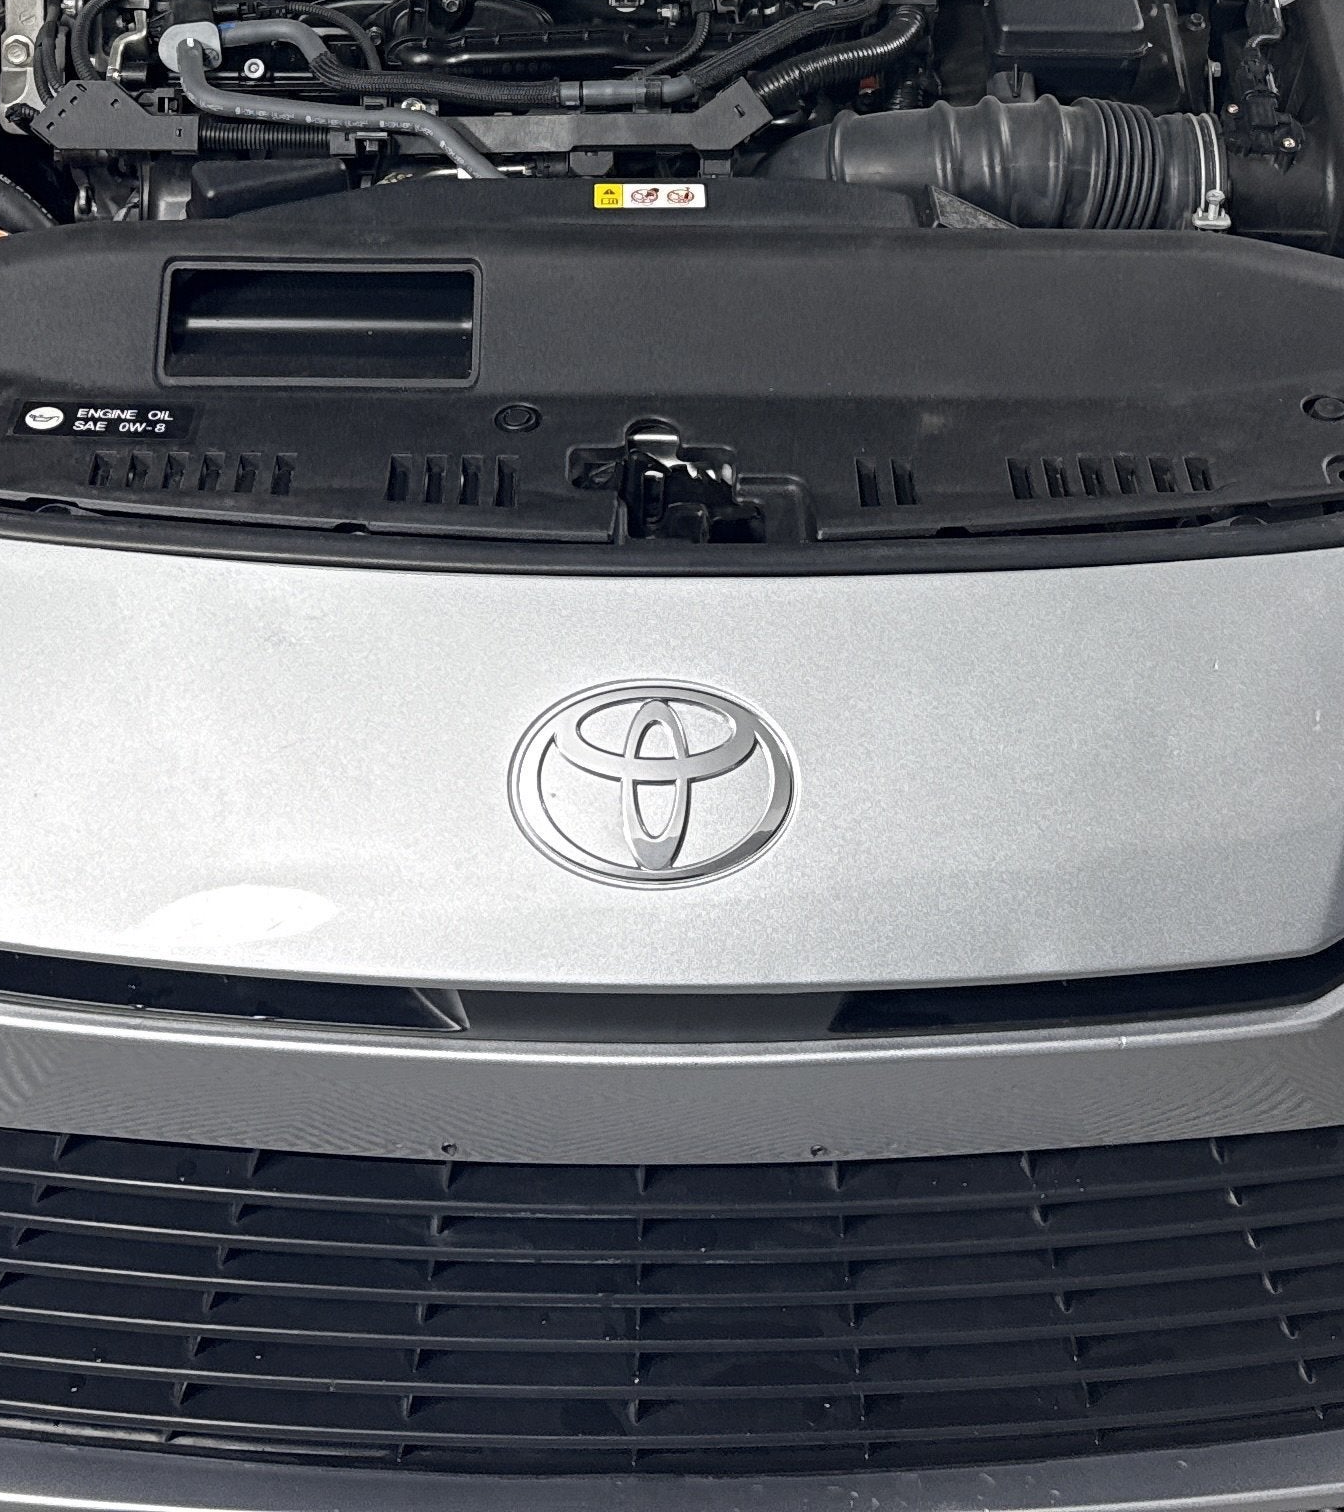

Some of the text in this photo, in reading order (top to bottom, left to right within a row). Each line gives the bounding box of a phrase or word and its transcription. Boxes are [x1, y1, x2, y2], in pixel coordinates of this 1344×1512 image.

[76, 408, 174, 421] ENGINE OIL
[72, 420, 166, 433] SAE 0W-8
